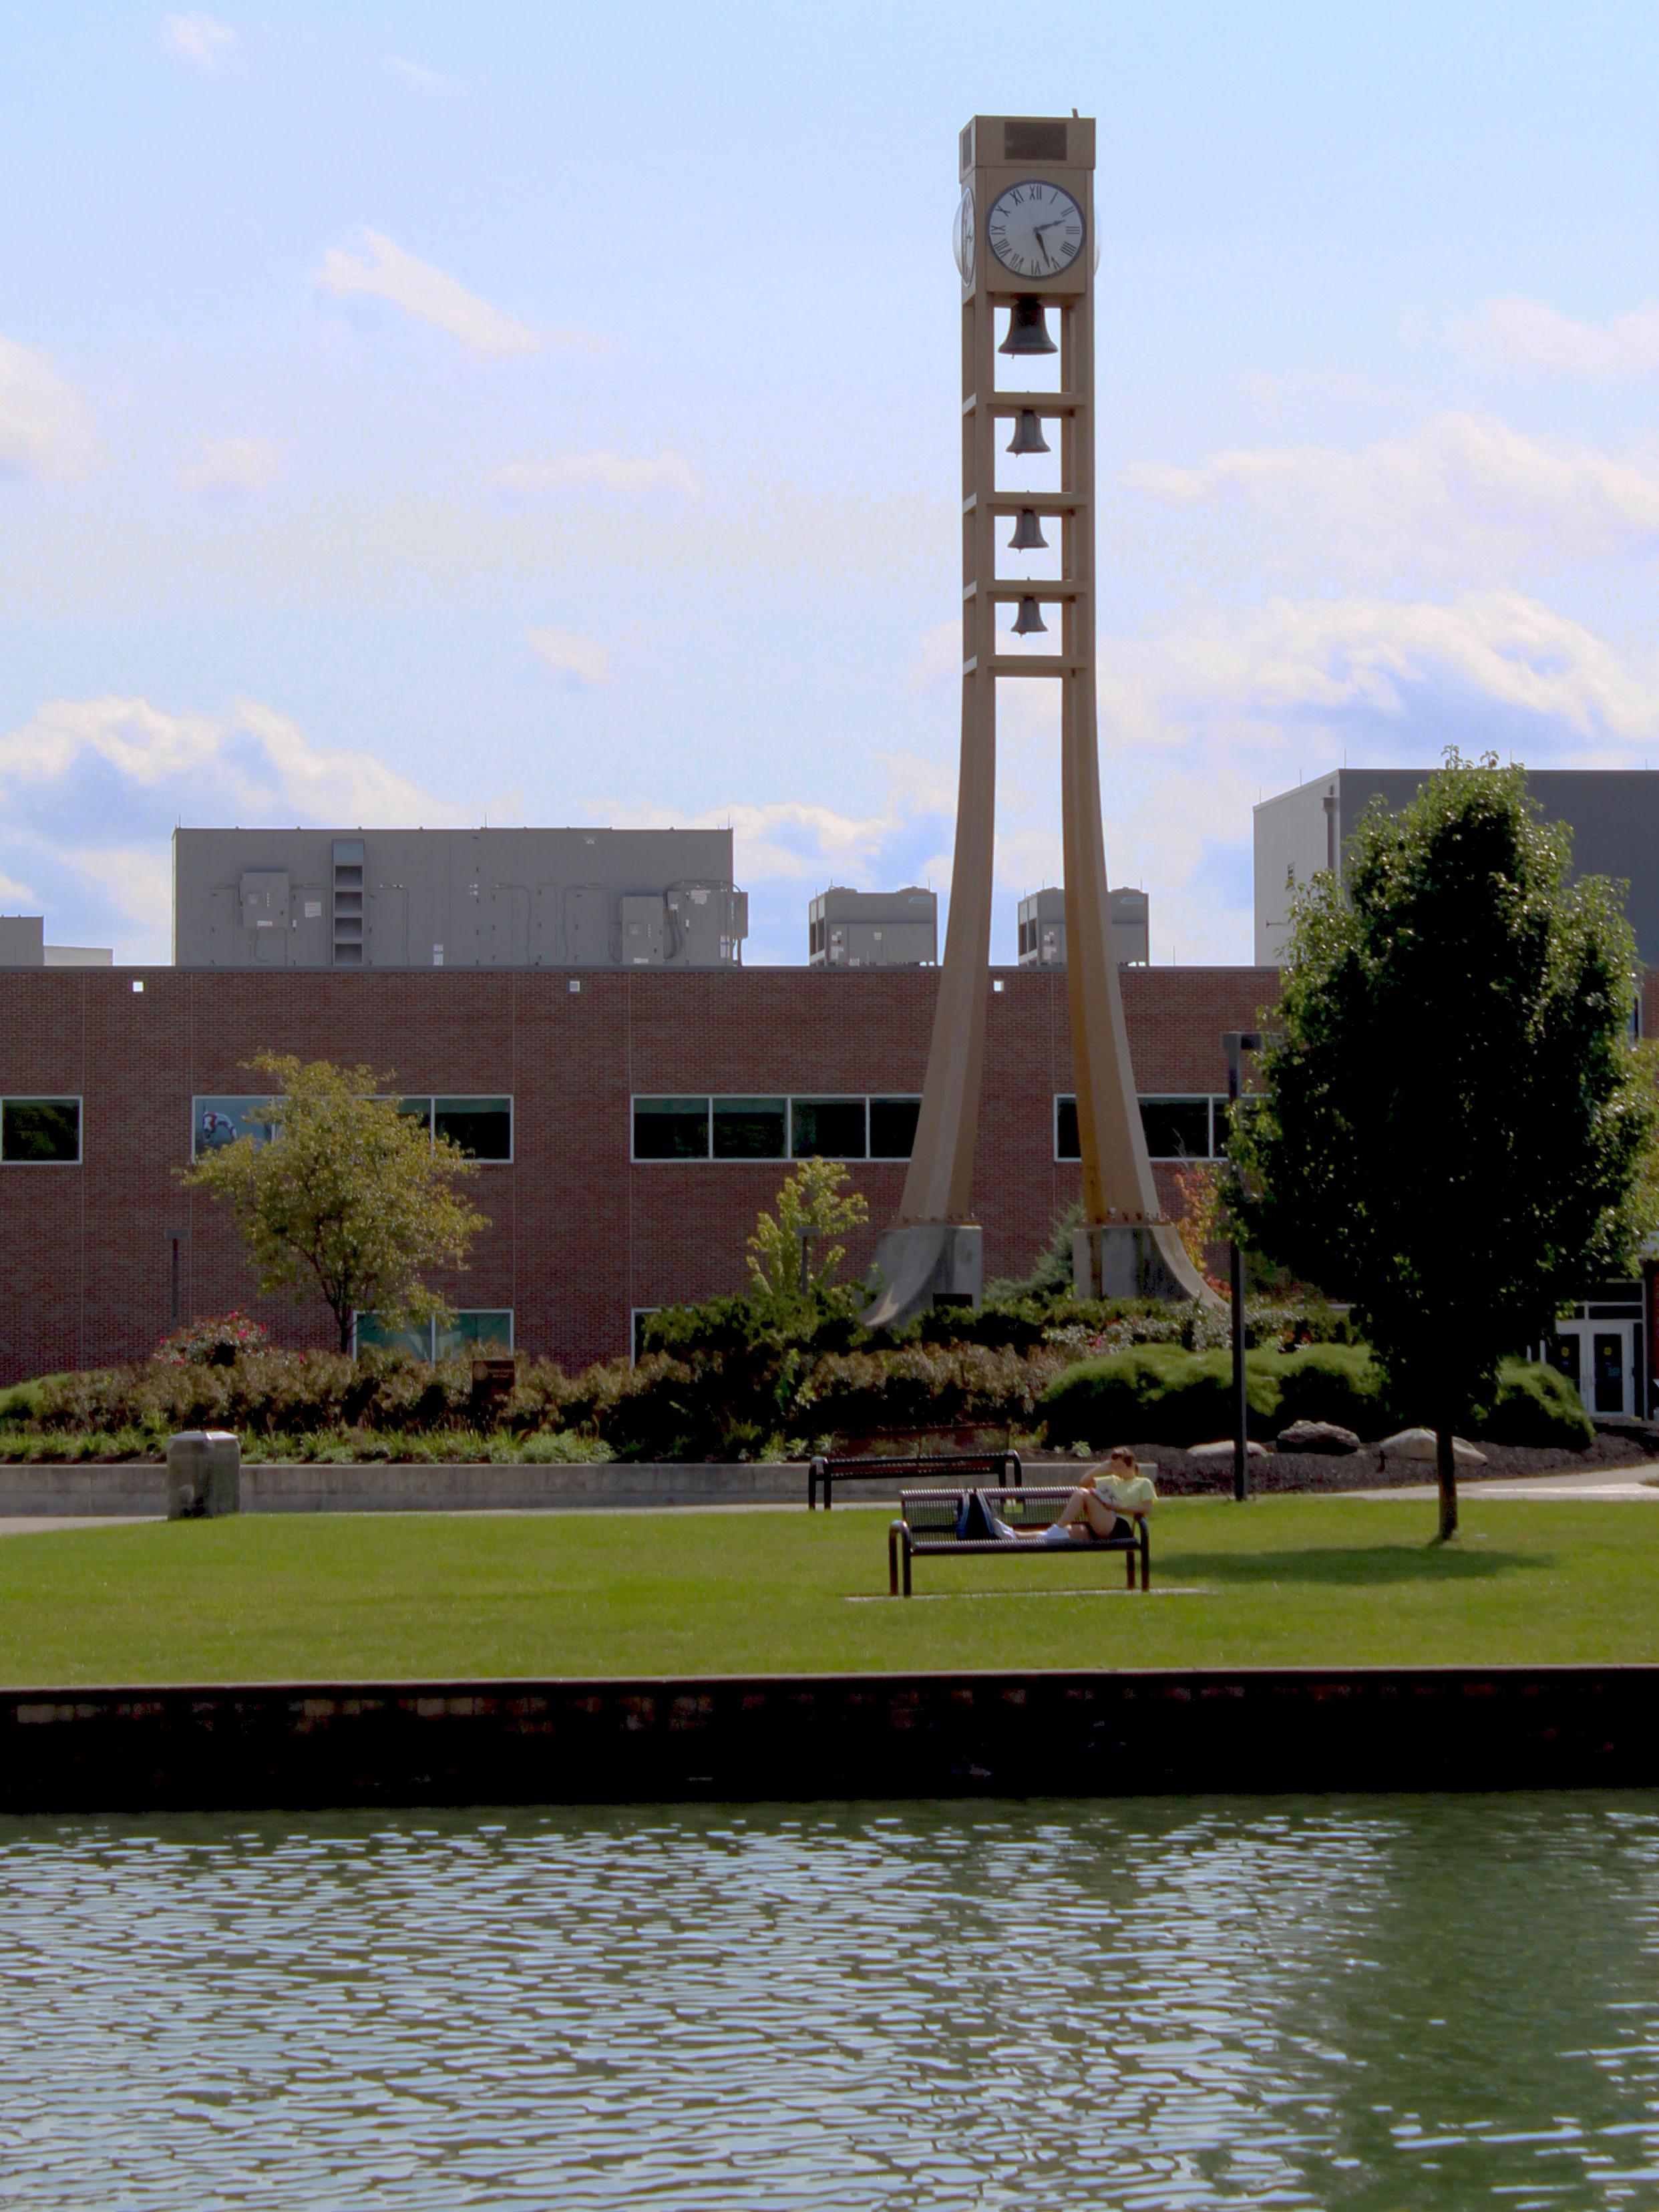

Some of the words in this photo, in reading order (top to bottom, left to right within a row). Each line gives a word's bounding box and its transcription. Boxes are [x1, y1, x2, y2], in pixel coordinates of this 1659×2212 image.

[1009, 188, 1025, 206] XI
[1029, 185, 1042, 200] XII
[1050, 191, 1059, 204] I
[995, 205, 1011, 218] X
[1061, 206, 1075, 217] II
[991, 225, 1006, 234] IX
[1066, 226, 1080, 234] III
[993, 238, 1012, 258] VIII
[1059, 241, 1077, 257] IIII
[1009, 253, 1025, 272] VII
[1031, 259, 1041, 275] VI
